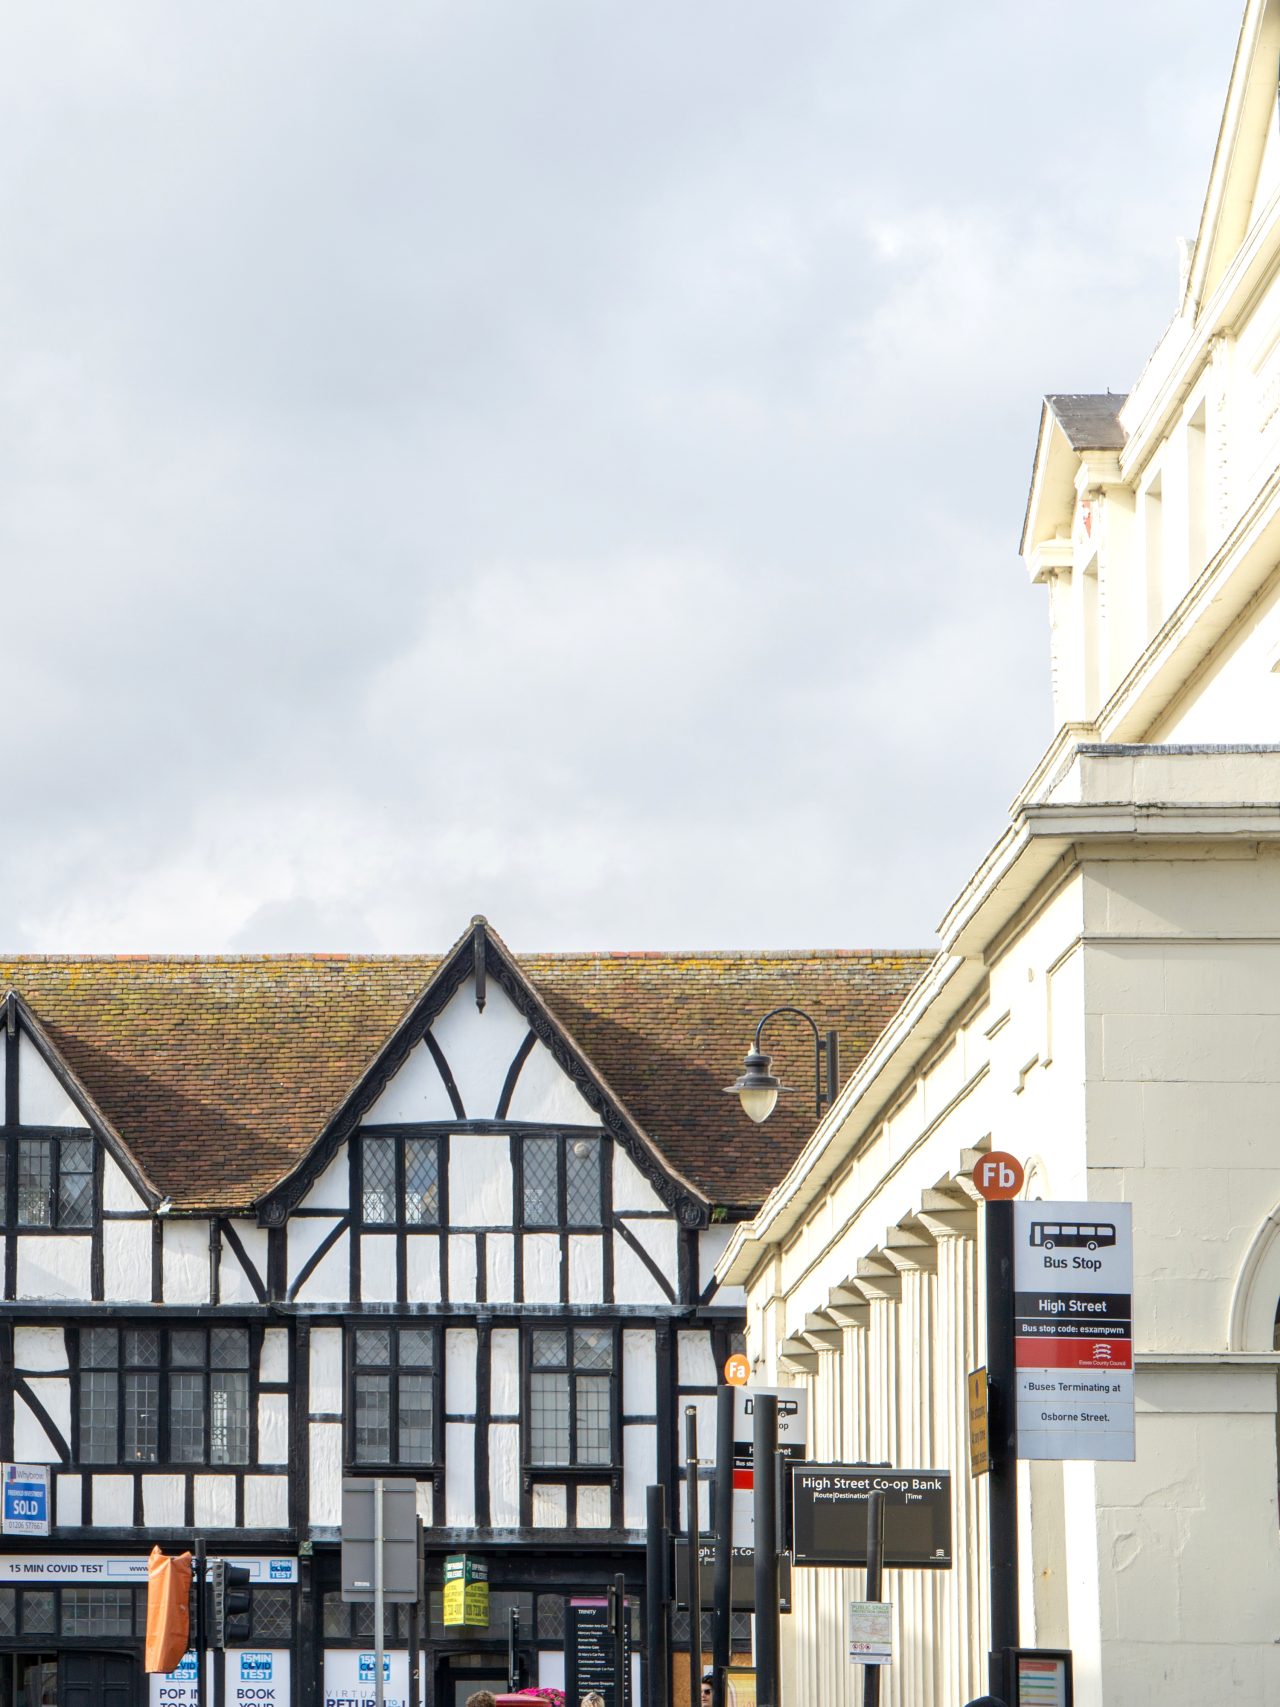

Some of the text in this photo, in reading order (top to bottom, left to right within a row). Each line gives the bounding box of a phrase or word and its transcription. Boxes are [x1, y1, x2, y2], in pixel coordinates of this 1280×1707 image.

[983, 1162, 1015, 1188] Fb
[1044, 1256, 1102, 1272] Bus Stop
[1039, 1300, 1107, 1314] High Street
[1022, 1324, 1125, 1335] Bus stop code: esxampwm
[729, 1362, 746, 1378] Fa
[1028, 1382, 1121, 1394] Buses Terminating at
[1041, 1412, 1110, 1422] Osborne Street.
[803, 1477, 942, 1491] High Street Co-op Bank
[13, 1500, 38, 1515] SOLD
[698, 1547, 710, 1557] gh
[9, 1564, 104, 1573] 15 MIN COVID TEST
[241, 1654, 271, 1662] 15MIN
[241, 1662, 271, 1670] COVID
[241, 1670, 271, 1679] TEST
[360, 1671, 389, 1680] TET
[413, 1669, 420, 1679] 2
[159, 1689, 186, 1699] POP
[236, 1689, 276, 1699] BOOK
[325, 1690, 377, 1698] VIRTUA
